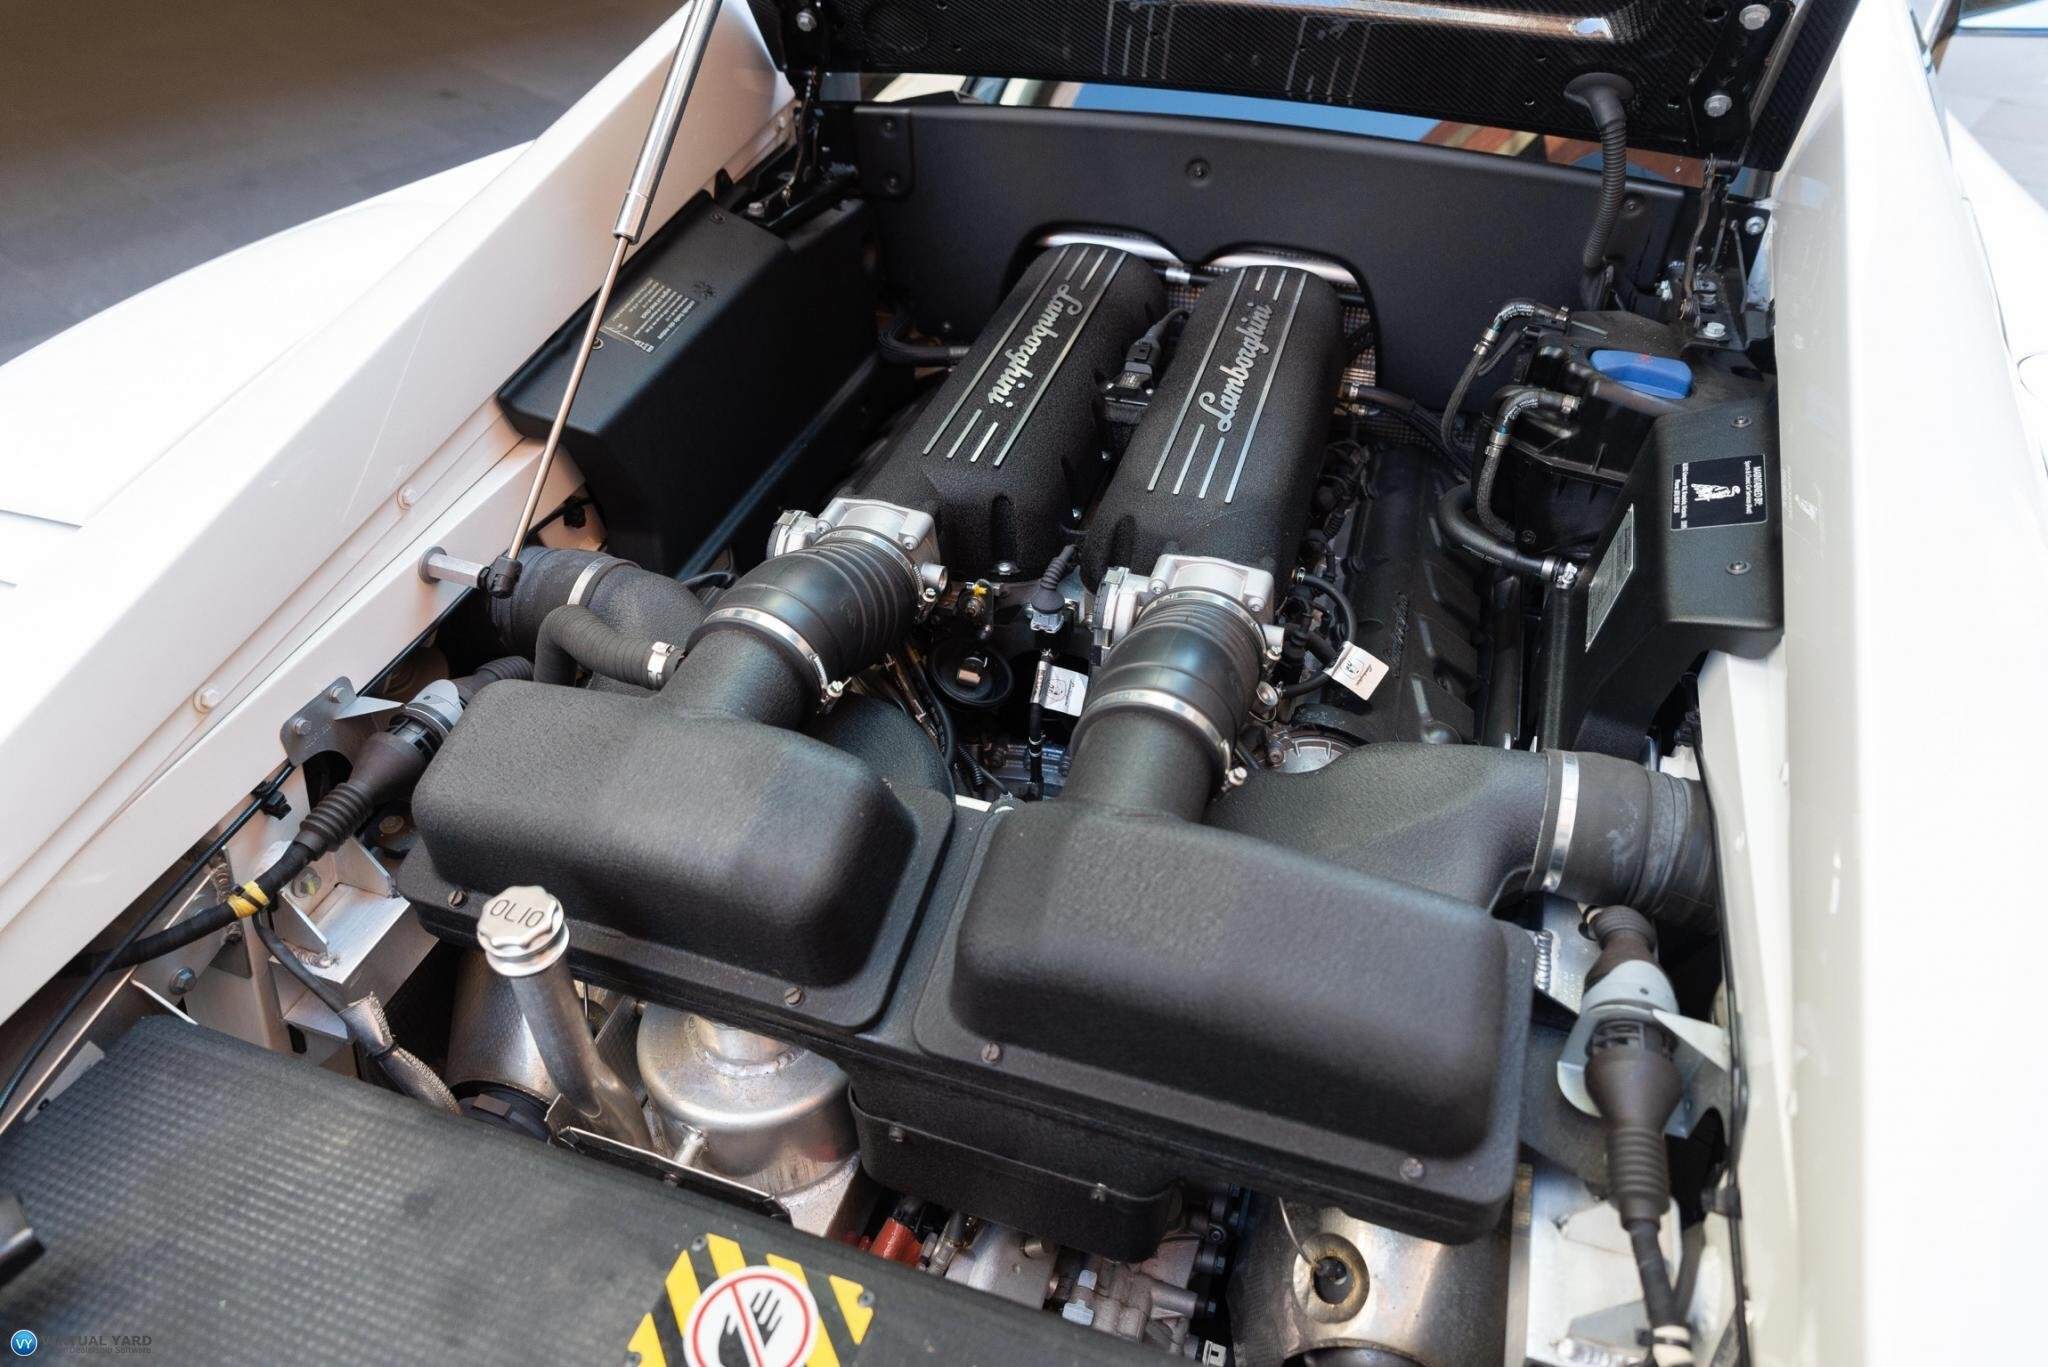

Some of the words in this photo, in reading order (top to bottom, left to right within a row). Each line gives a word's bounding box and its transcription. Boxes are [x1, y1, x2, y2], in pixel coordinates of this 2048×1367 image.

[988, 284, 1083, 408] Lamborghini
[1199, 302, 1272, 432] Lamborghini
[1753, 466, 1762, 497] MAINTAINED
[490, 899, 545, 928] OLIO
